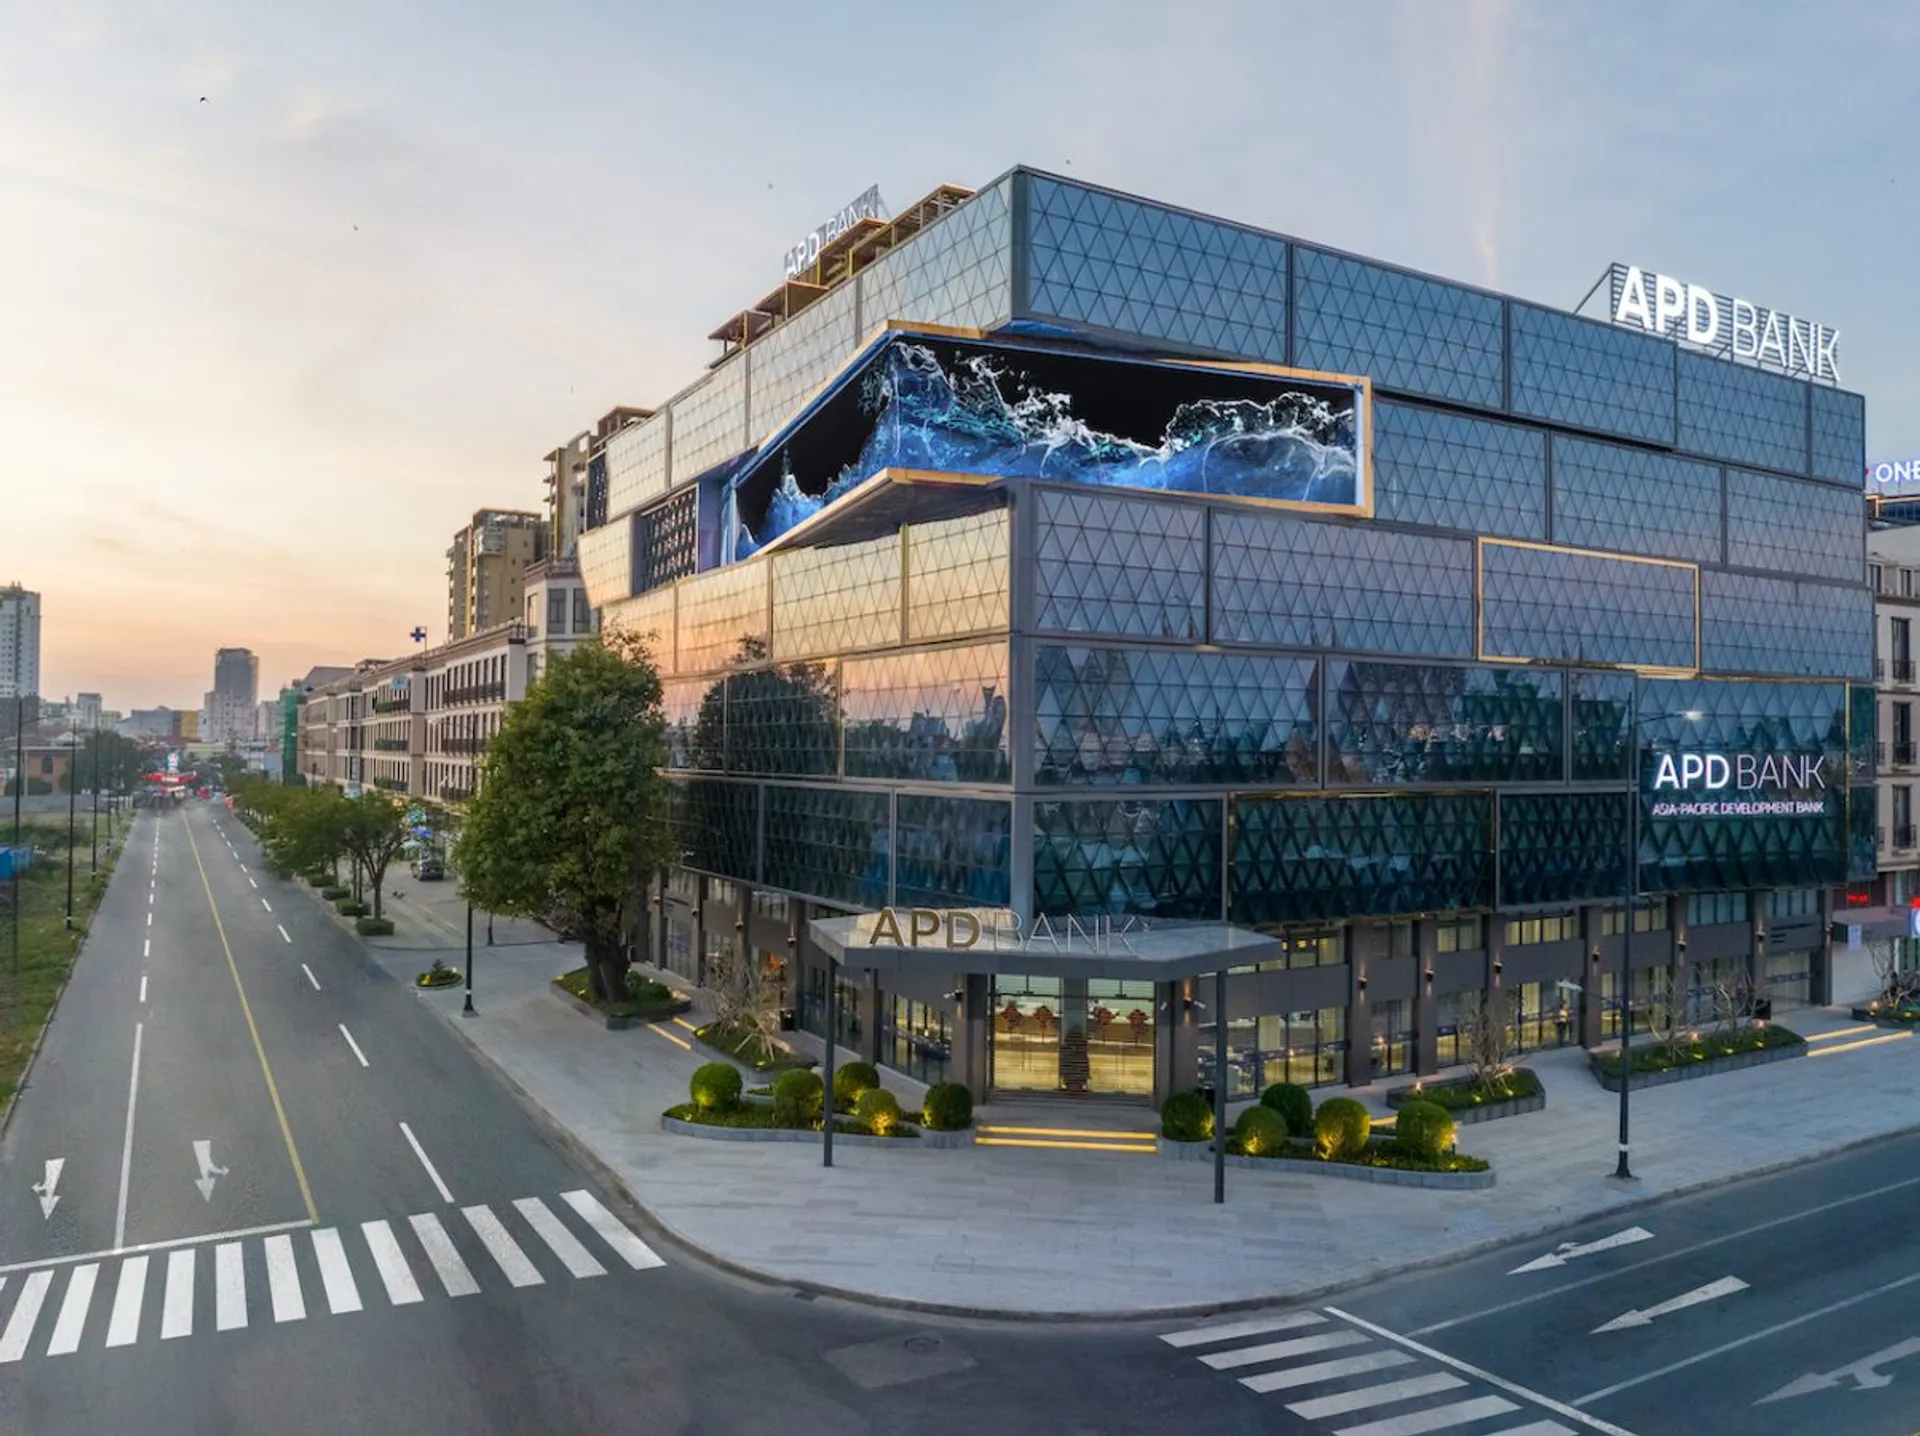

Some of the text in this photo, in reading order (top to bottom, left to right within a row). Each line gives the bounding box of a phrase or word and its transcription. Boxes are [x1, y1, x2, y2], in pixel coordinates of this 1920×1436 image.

[784, 231, 820, 279] APD
[1615, 266, 1841, 382] APD BANK
[1654, 754, 1826, 790] APD BANK
[1652, 801, 1824, 816] ASIA-PACIFIC DEVELOPMENT BANK
[868, 907, 1137, 958] APD BANK
